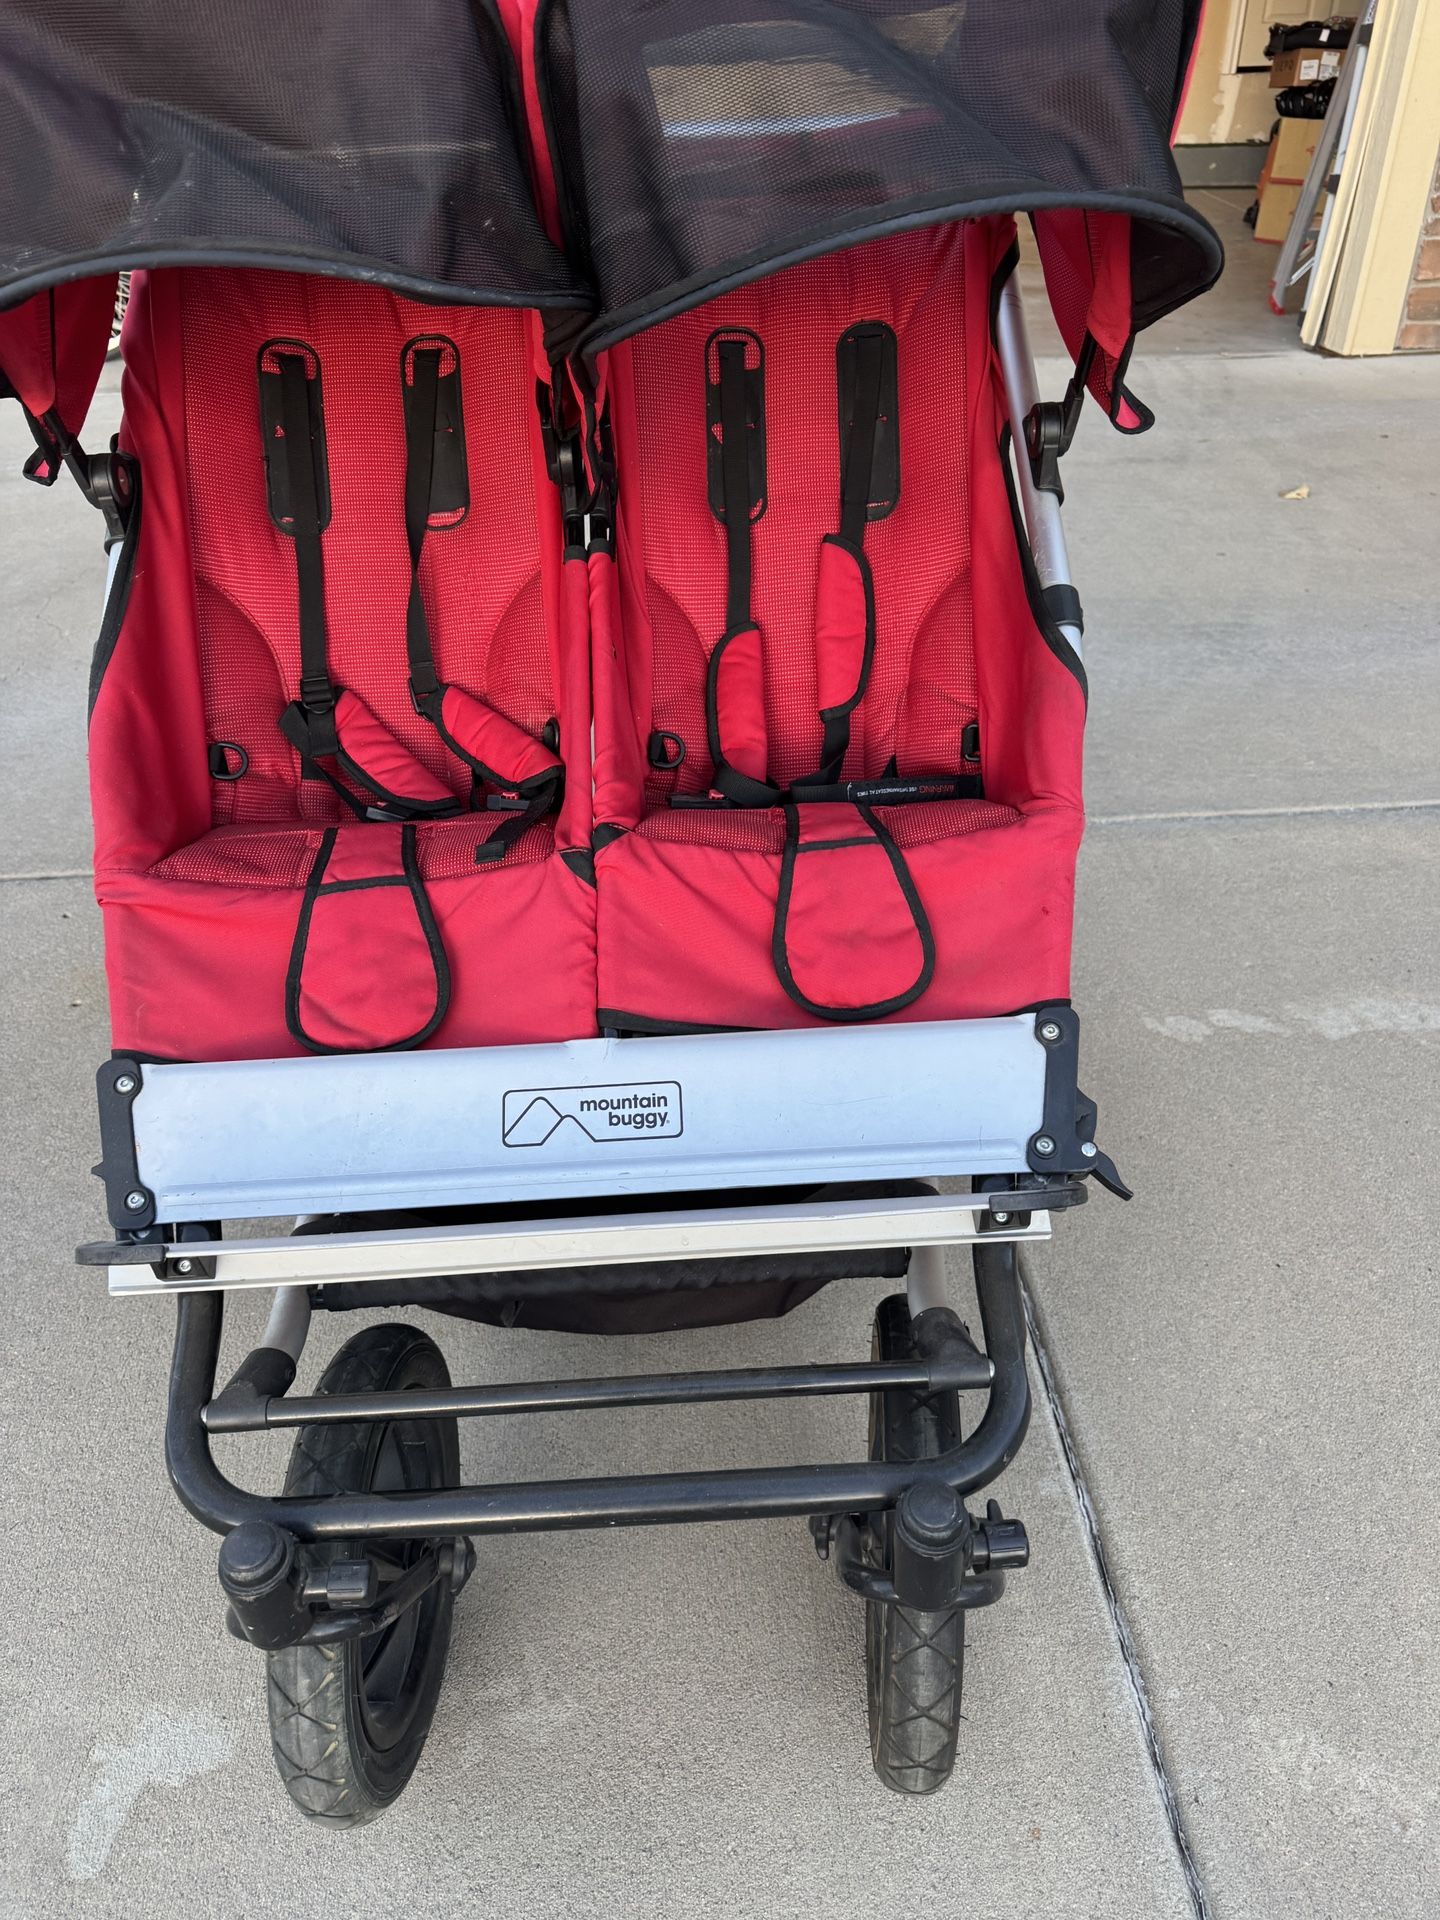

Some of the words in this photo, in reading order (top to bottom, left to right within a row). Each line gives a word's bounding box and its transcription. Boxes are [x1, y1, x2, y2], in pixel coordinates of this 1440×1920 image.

[918, 785, 955, 794] WARNING
[580, 1092, 668, 1112] mountain
[608, 1111, 669, 1130] buggy
